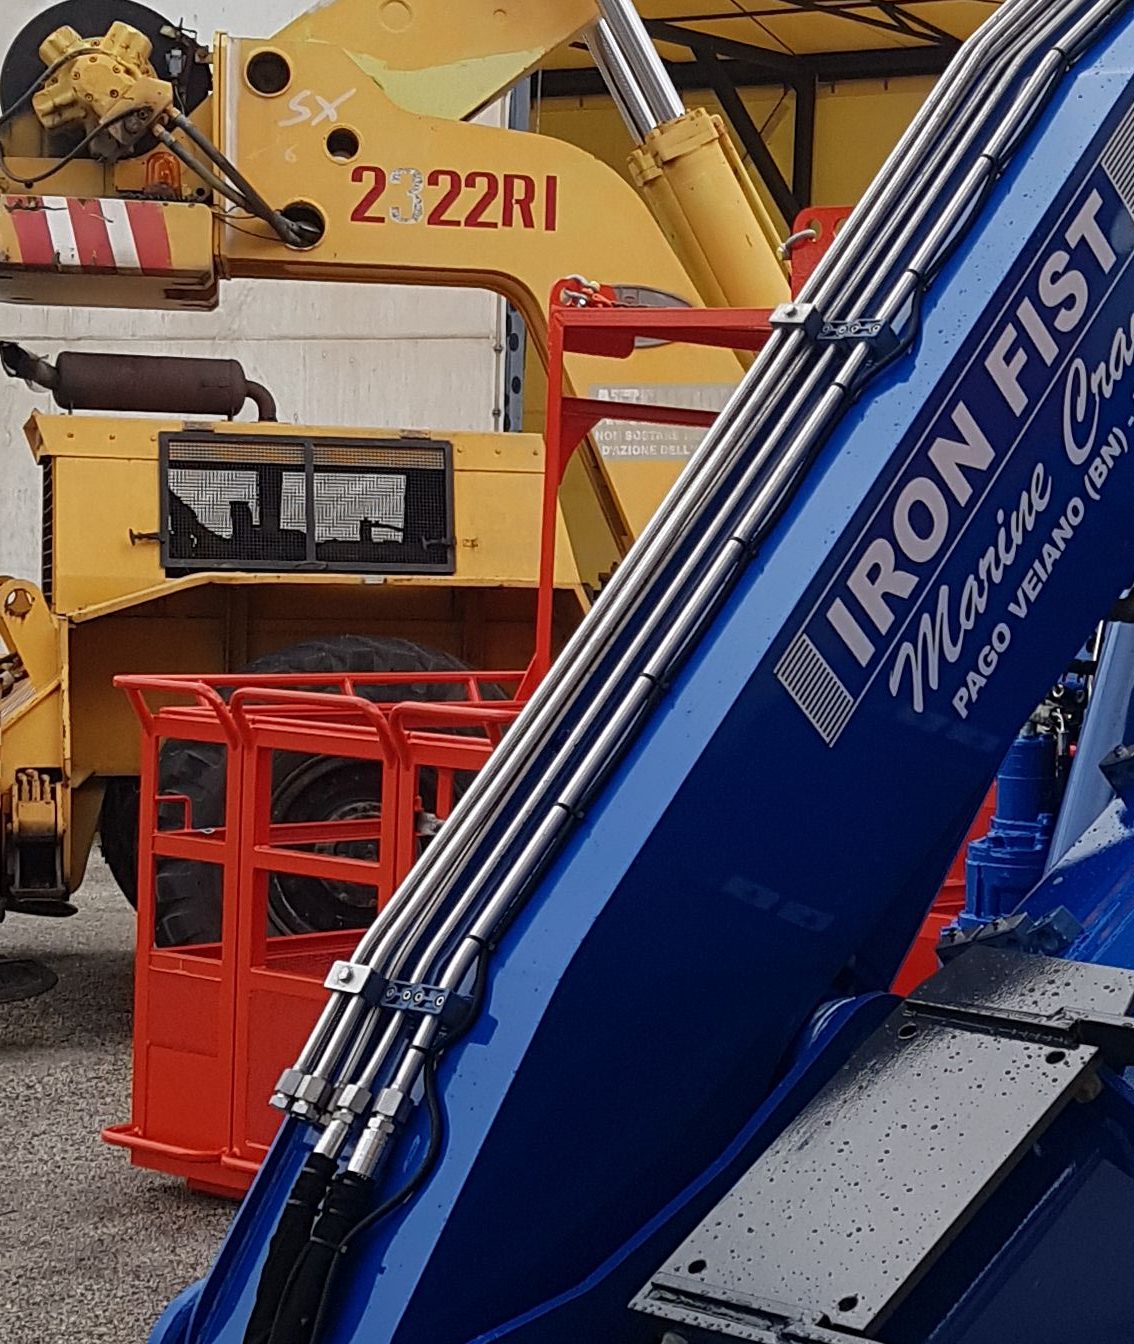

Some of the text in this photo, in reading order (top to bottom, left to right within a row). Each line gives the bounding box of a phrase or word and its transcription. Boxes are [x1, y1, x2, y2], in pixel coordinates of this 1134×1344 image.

[278, 88, 357, 127] SX
[350, 165, 558, 232] 2322RI
[827, 188, 1116, 667] IRON FIST
[889, 462, 1052, 713] Marine
[952, 629, 1012, 719] PAGO
[1008, 496, 1086, 619] VEIANO
[1084, 433, 1129, 503] (BN)
